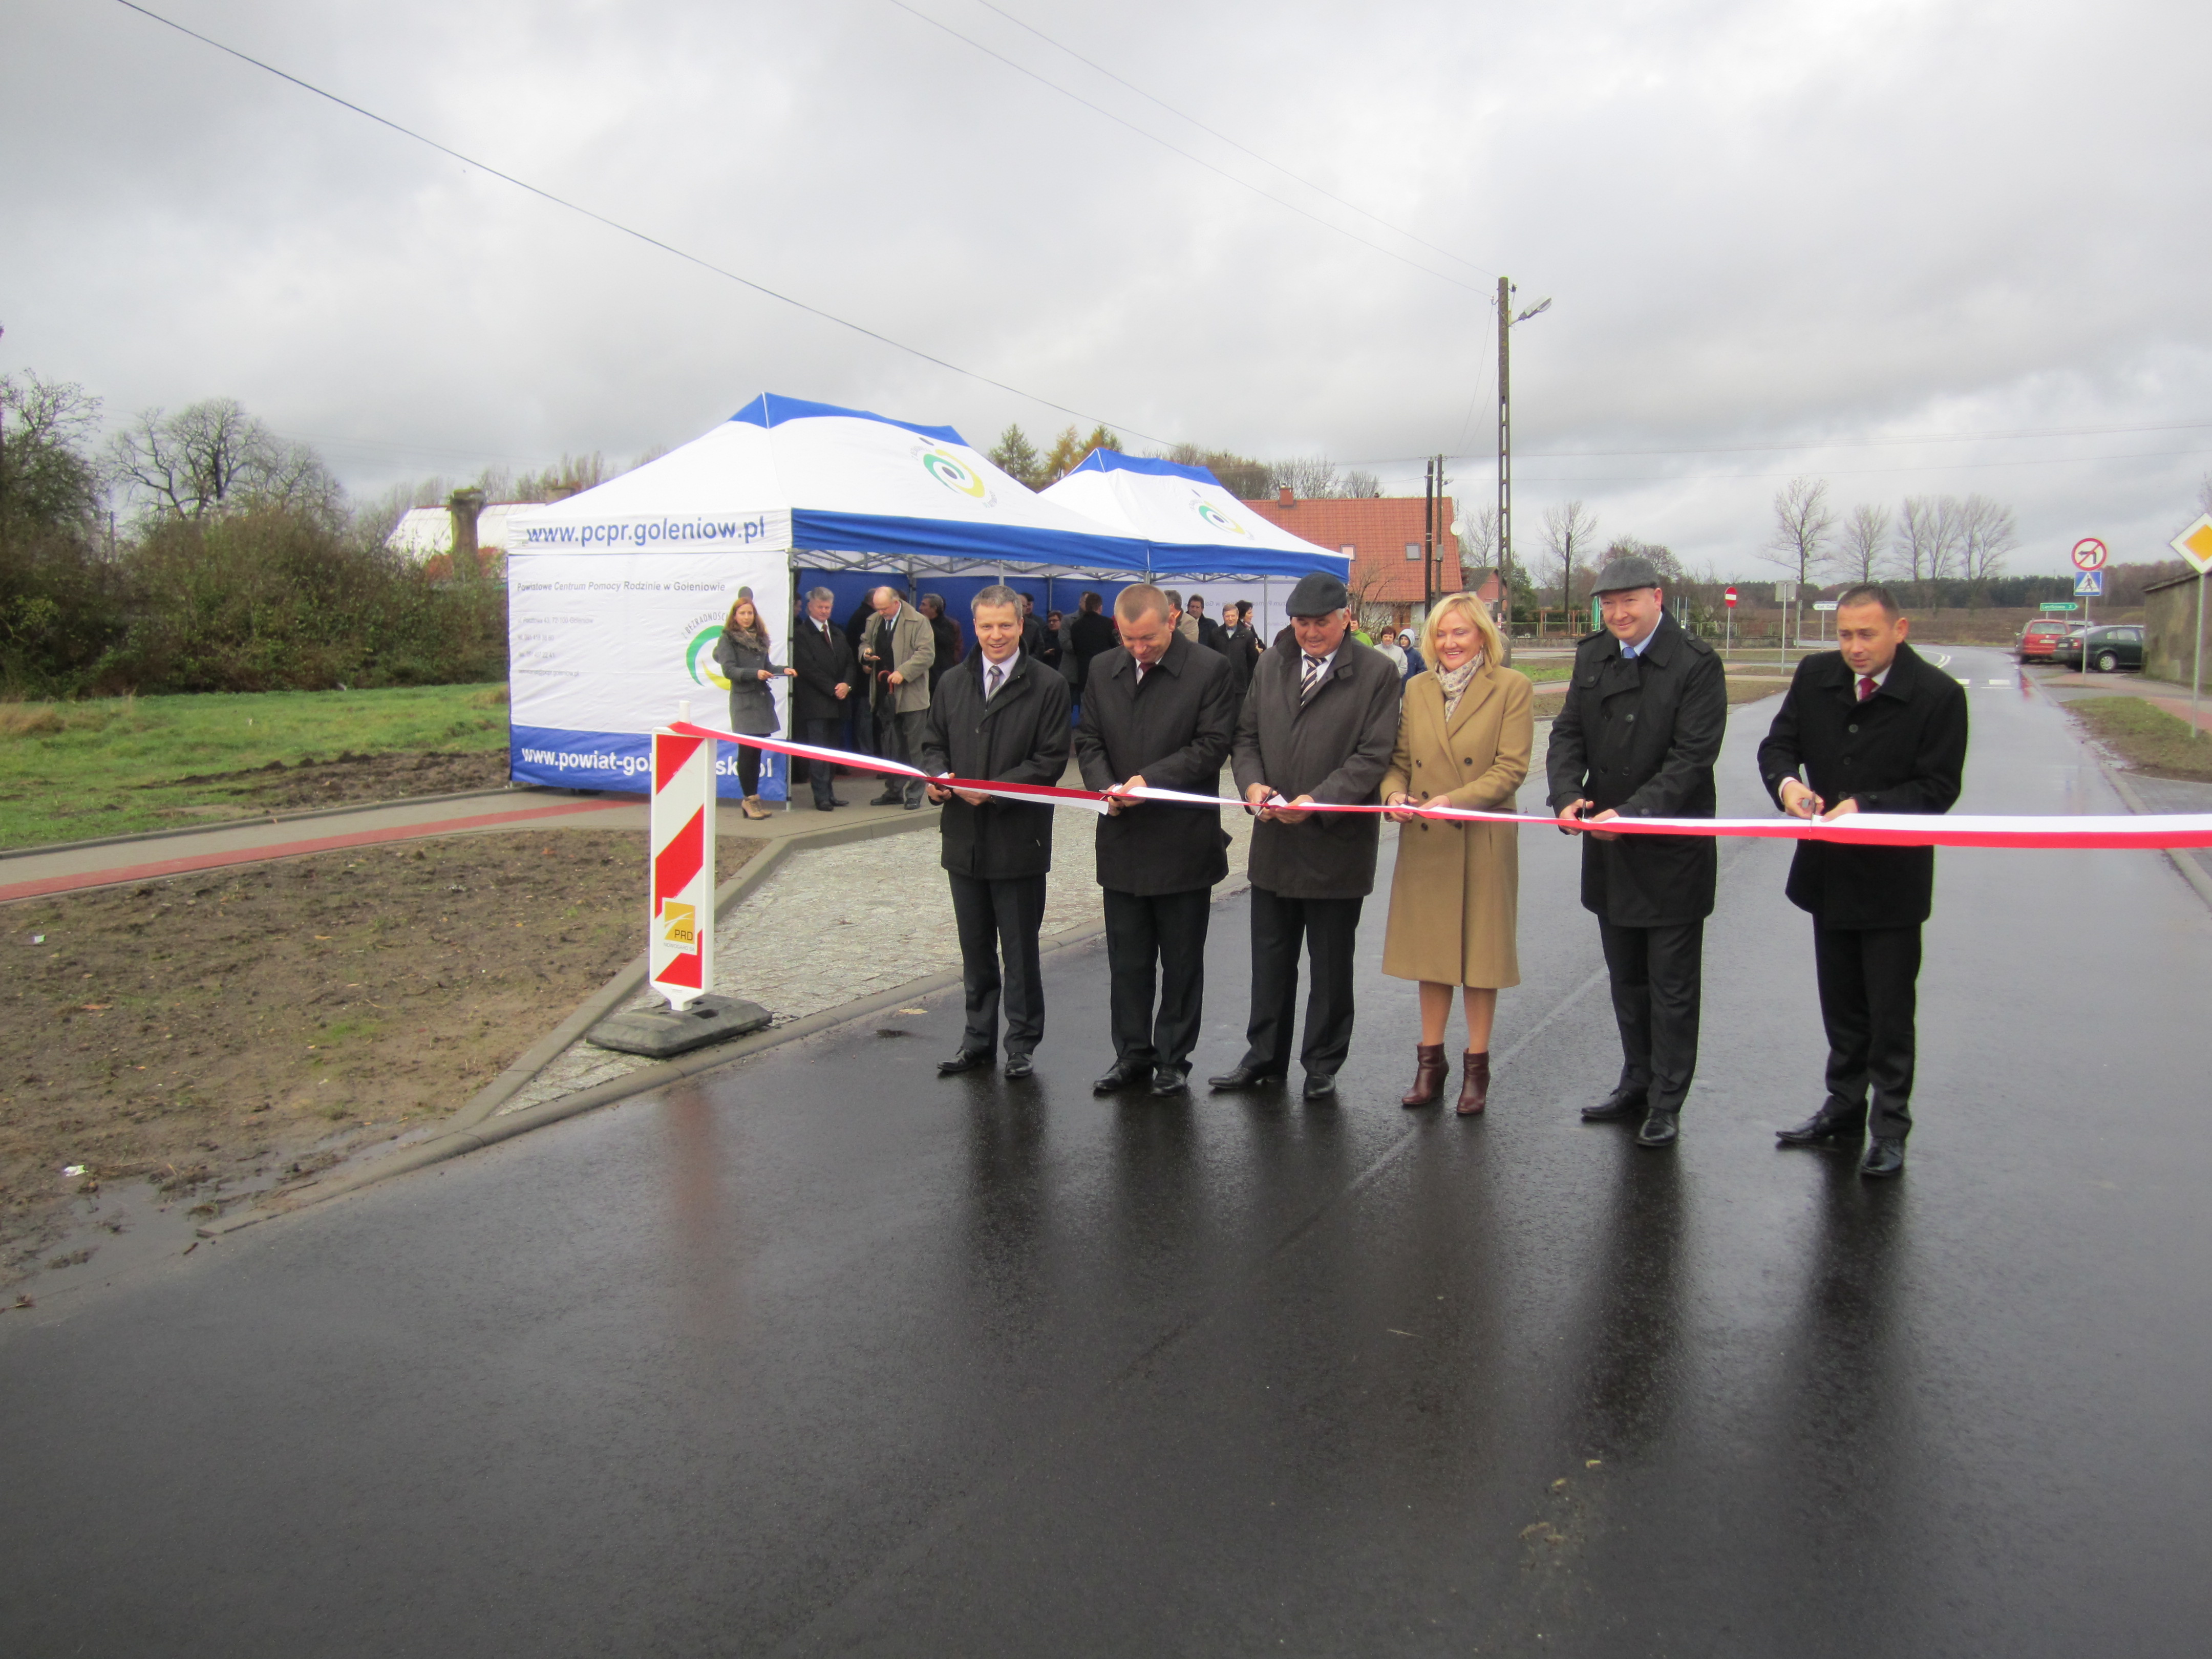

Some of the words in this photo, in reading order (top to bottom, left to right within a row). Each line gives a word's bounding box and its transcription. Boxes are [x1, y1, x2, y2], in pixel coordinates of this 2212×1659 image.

[526, 516, 764, 546] www.pcpr.goleniow.pl
[517, 583, 552, 591] Powiatowe
[554, 581, 585, 590] Centrum
[588, 581, 621, 592] Pomocy
[623, 581, 661, 590] Rodzinie
[673, 582, 726, 591] Goleniowie
[674, 929, 693, 941] PRD
[664, 942, 688, 950] NOWOGARD
